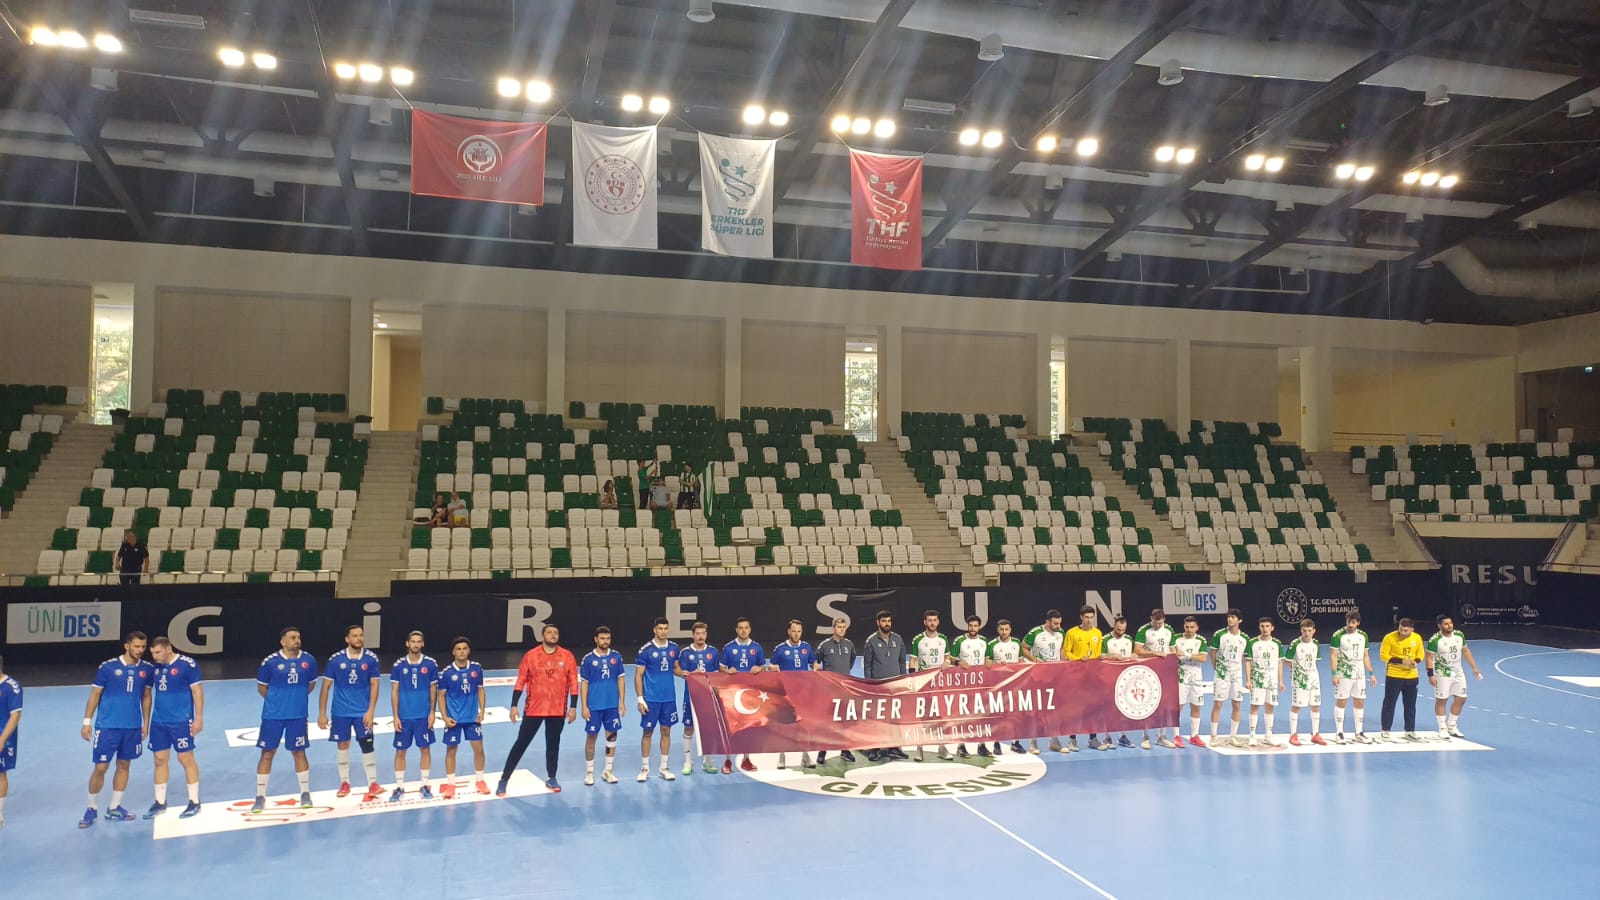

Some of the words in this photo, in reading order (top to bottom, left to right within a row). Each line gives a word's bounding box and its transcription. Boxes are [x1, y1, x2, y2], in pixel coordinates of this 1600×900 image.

[711, 214, 764, 226] ERKEKLER
[710, 223, 743, 235] SÜPER
[866, 217, 910, 237] THF
[1157, 638, 1164, 646] 15
[287, 673, 298, 684] 20
[930, 671, 984, 688] AĞUSTOS
[832, 697, 902, 723] ZAFER
[915, 688, 1056, 719] BAYRAMIMIZ
[904, 726, 944, 742] KUTLU
[951, 724, 992, 739] OLSUN
[177, 737, 189, 749] 26
